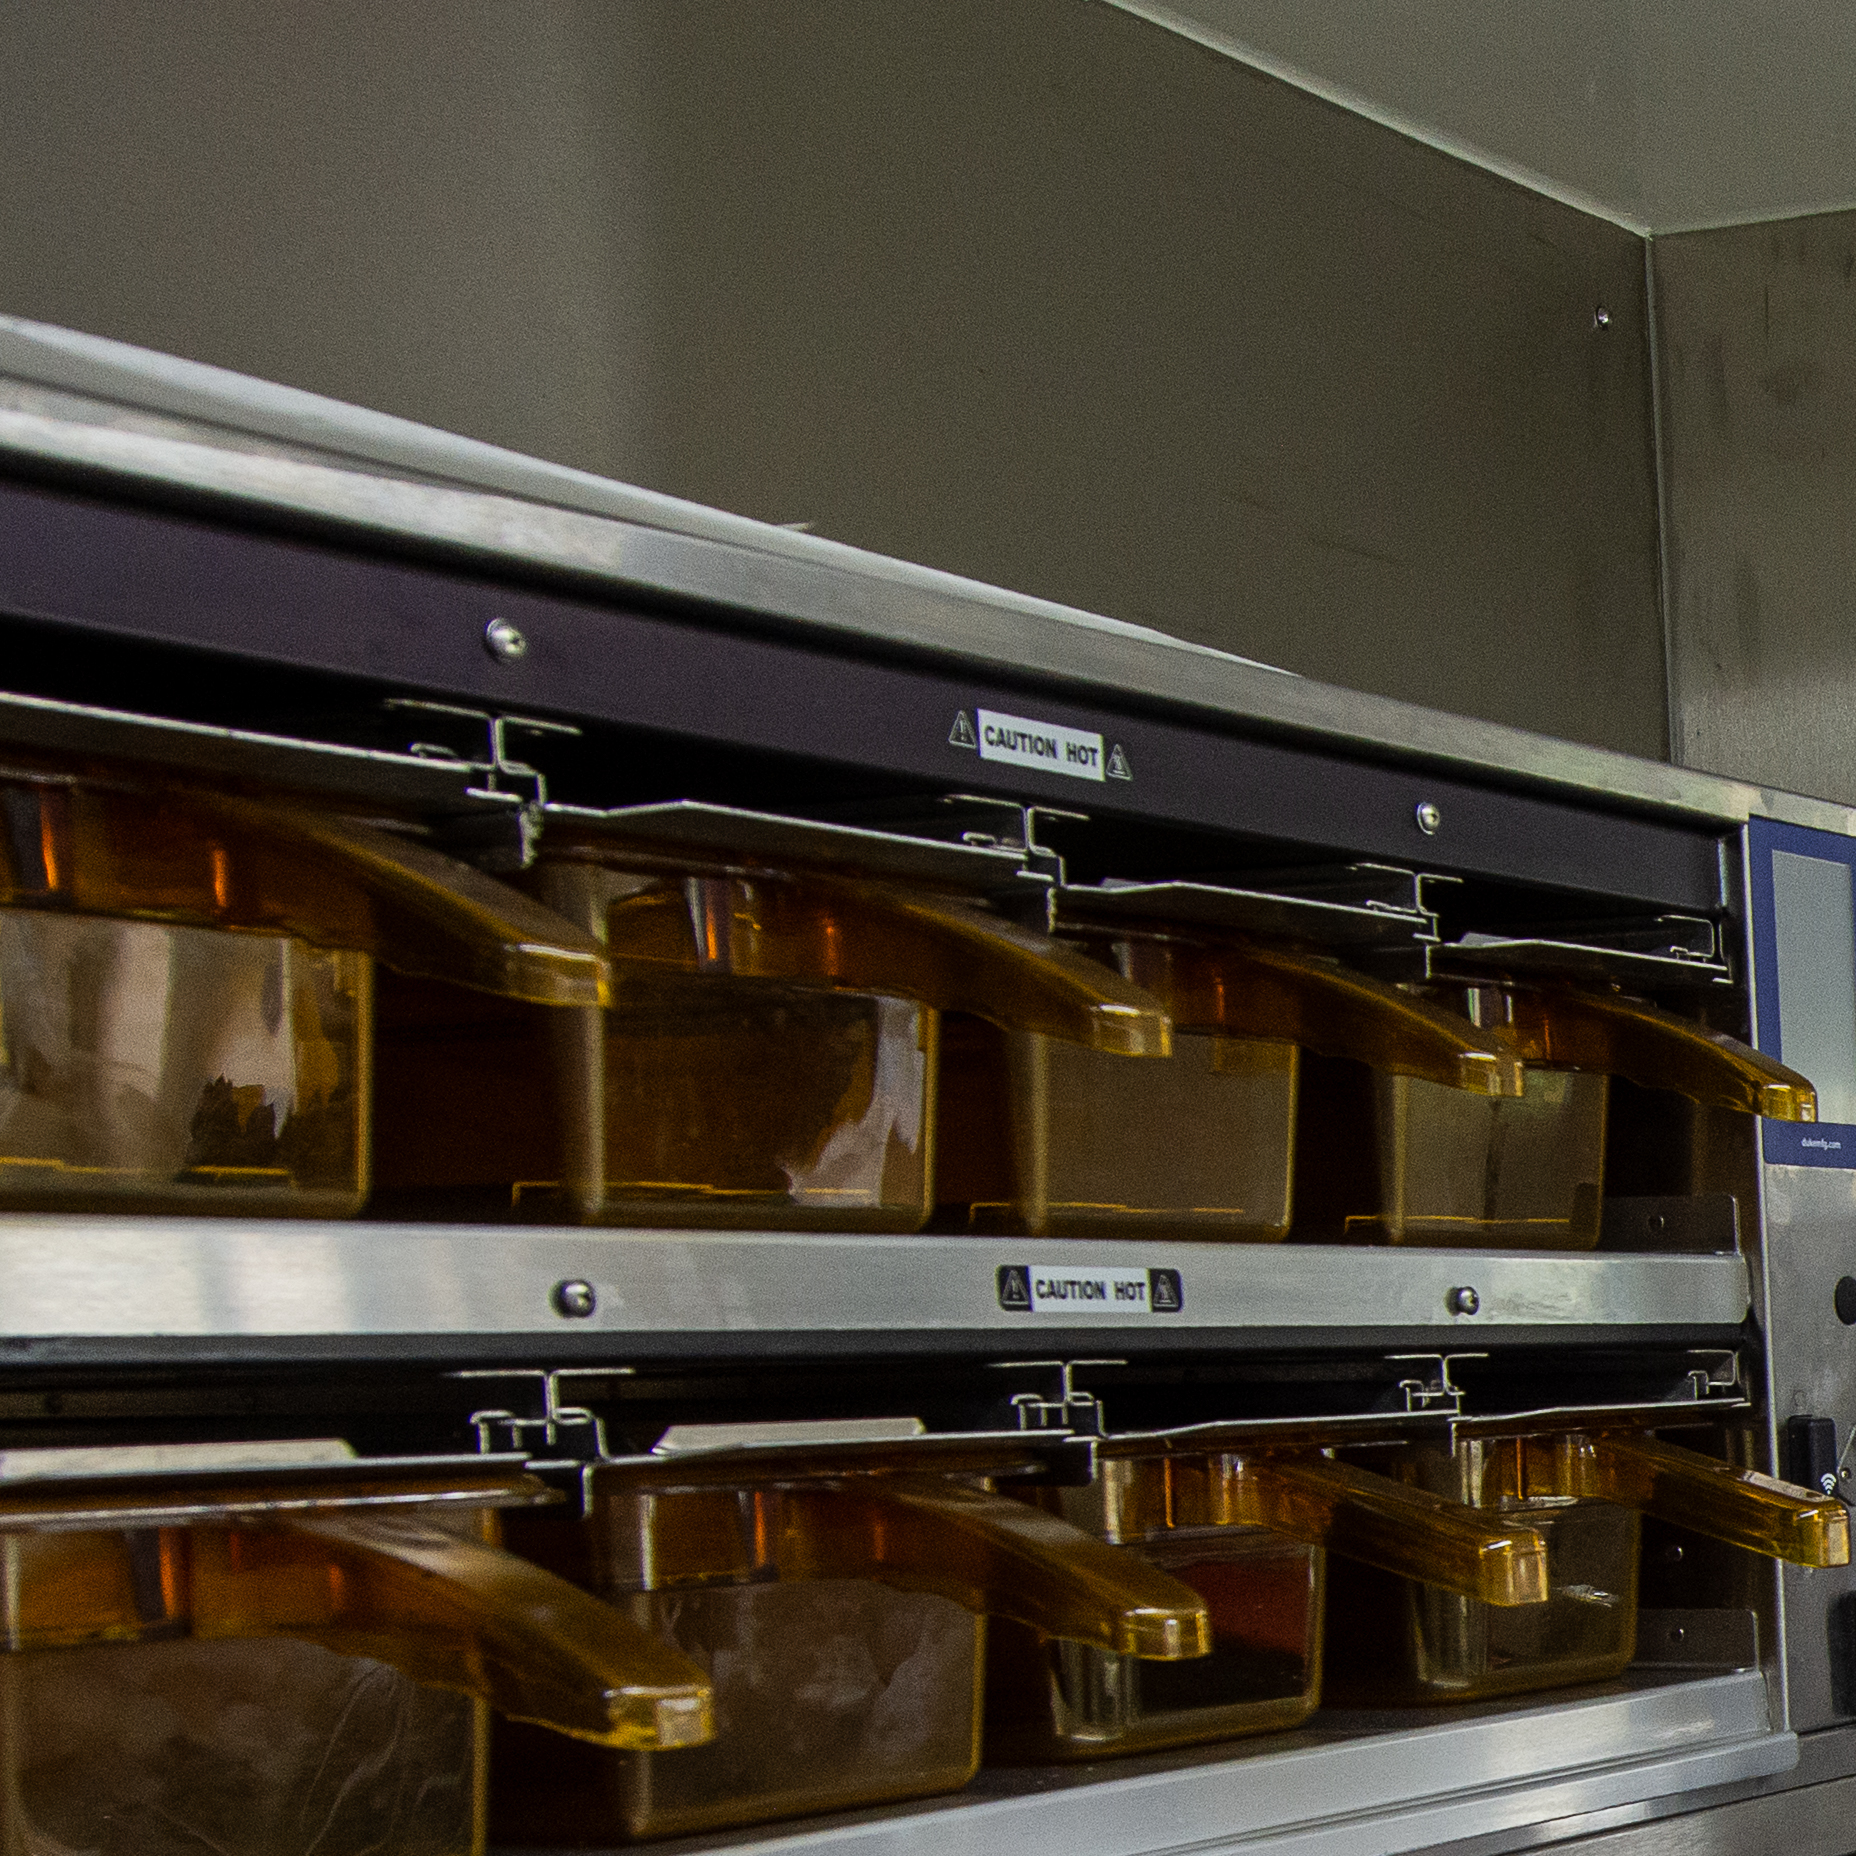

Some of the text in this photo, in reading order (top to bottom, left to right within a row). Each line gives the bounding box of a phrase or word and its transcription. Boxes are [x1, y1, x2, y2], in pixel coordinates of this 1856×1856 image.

[984, 725, 1099, 767] CAUTION HOT
[1035, 1279, 1145, 1301] CAUTION HOT
